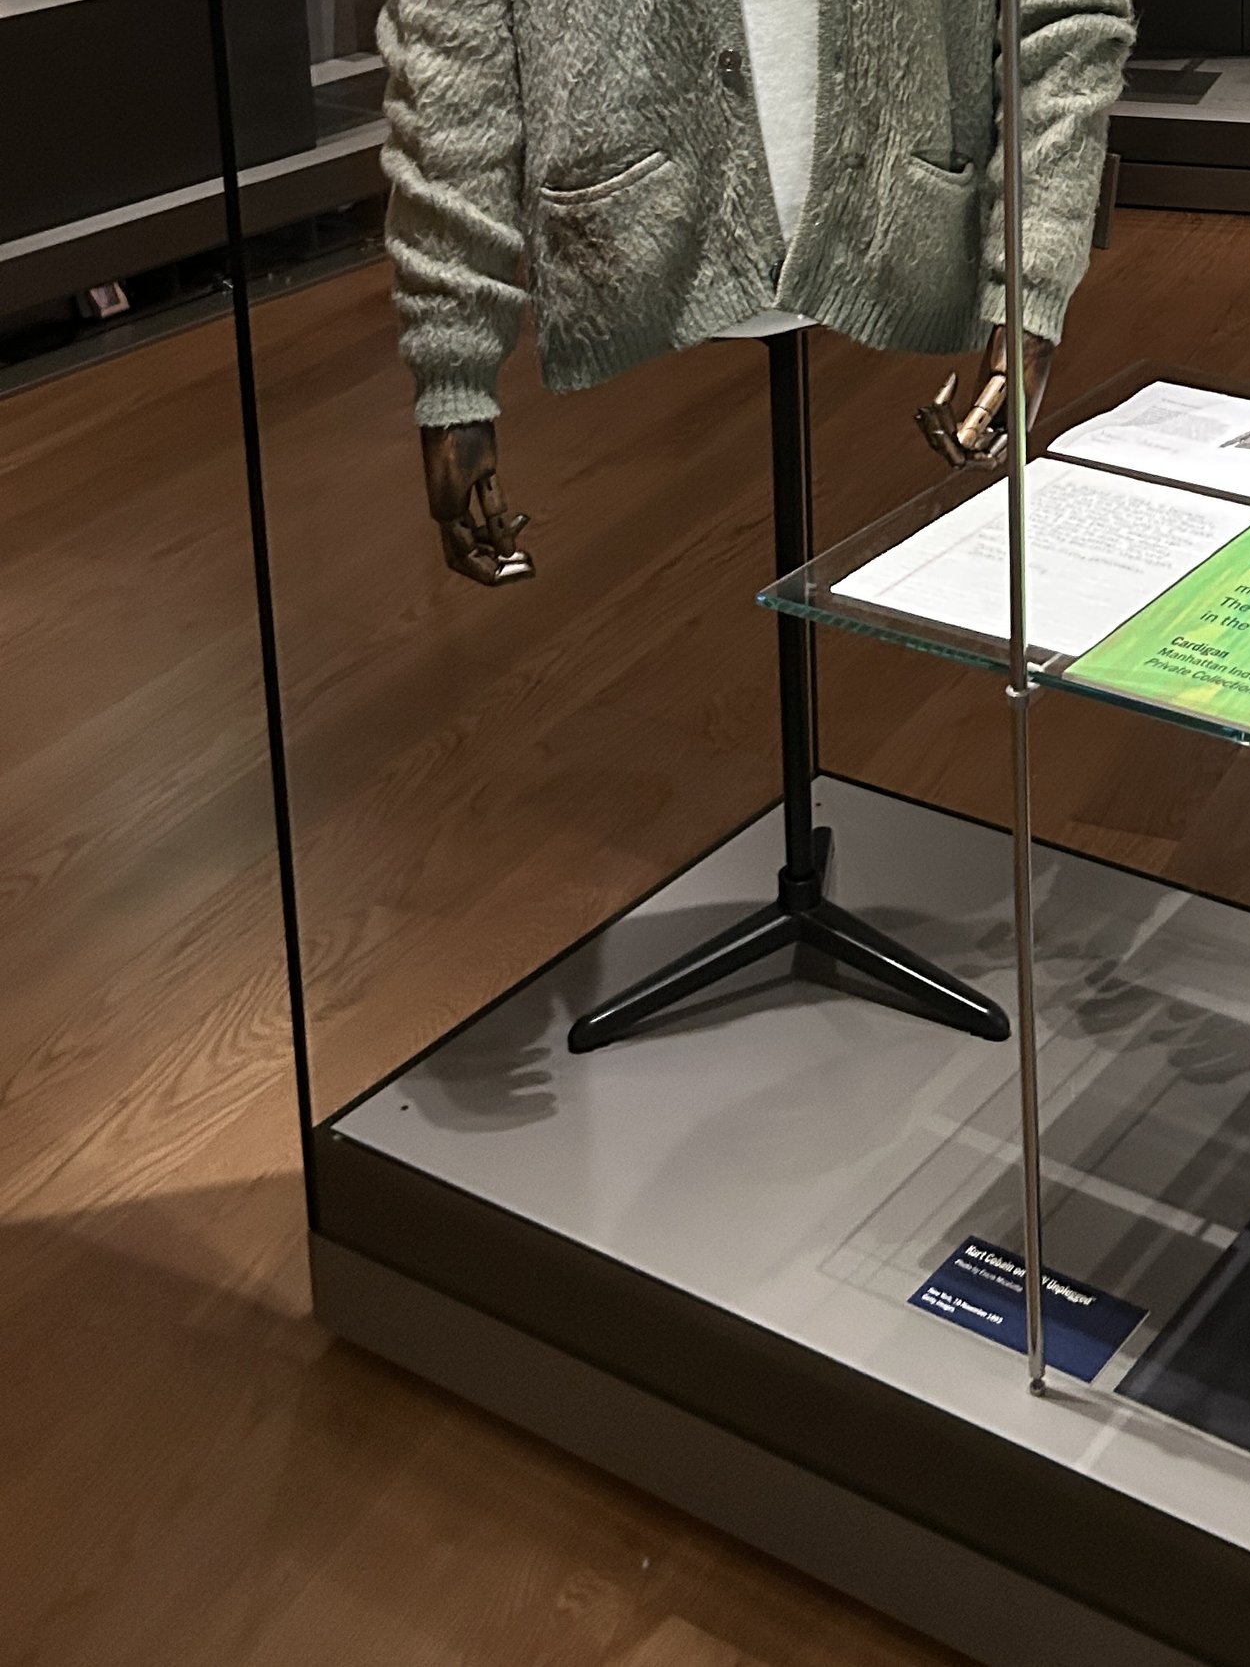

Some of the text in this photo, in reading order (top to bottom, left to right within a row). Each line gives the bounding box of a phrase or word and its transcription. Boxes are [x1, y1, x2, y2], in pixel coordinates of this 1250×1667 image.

[1220, 596, 1250, 613] The
[1200, 610, 1218, 623] in
[1220, 614, 1250, 630] the
[1171, 636, 1230, 659] Cardigan
[1144, 658, 1192, 676] Private
[1157, 647, 1228, 674] Manhattan
[965, 1245, 984, 1261] Kurt
[984, 1252, 1015, 1274] Cobain
[1013, 1266, 1026, 1278] on
